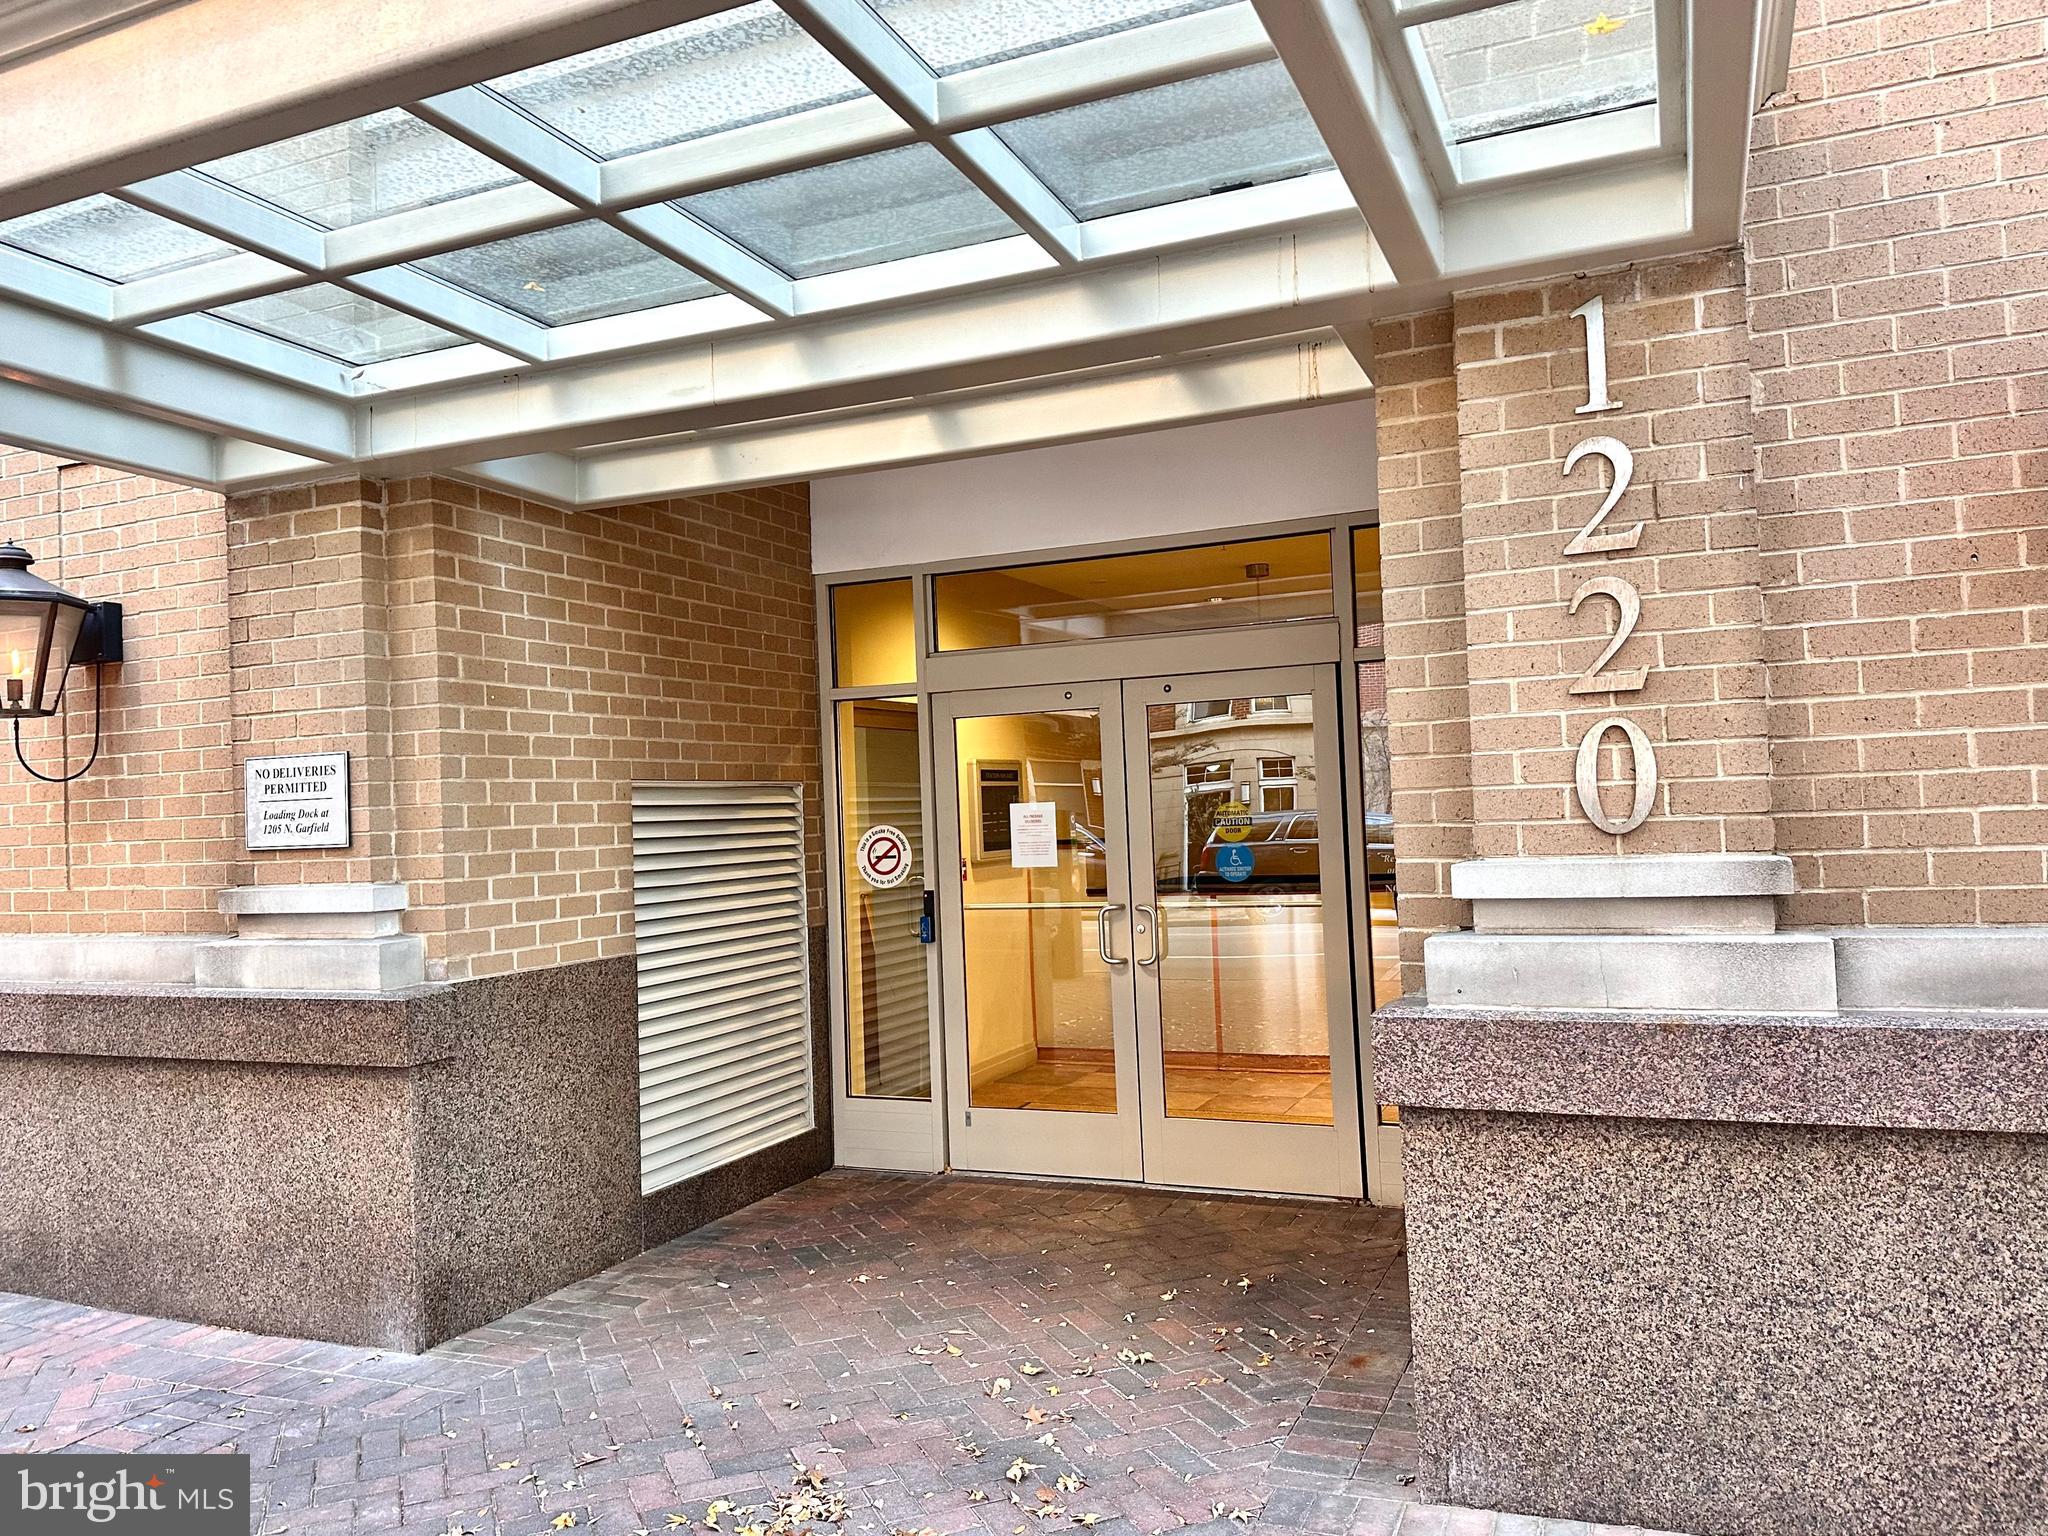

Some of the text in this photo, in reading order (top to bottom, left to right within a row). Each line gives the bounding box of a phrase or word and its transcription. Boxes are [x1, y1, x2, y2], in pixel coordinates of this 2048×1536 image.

[1562, 294, 1657, 835] 1220
[255, 765, 336, 780] NO DELIVERIES
[264, 781, 327, 795] PERMITTED
[263, 808, 329, 821] Loading Dock at
[1216, 809, 1249, 817] AUTOMATIC
[1215, 817, 1250, 826] CAUTION
[263, 822, 330, 835] 1205 N. Garfield
